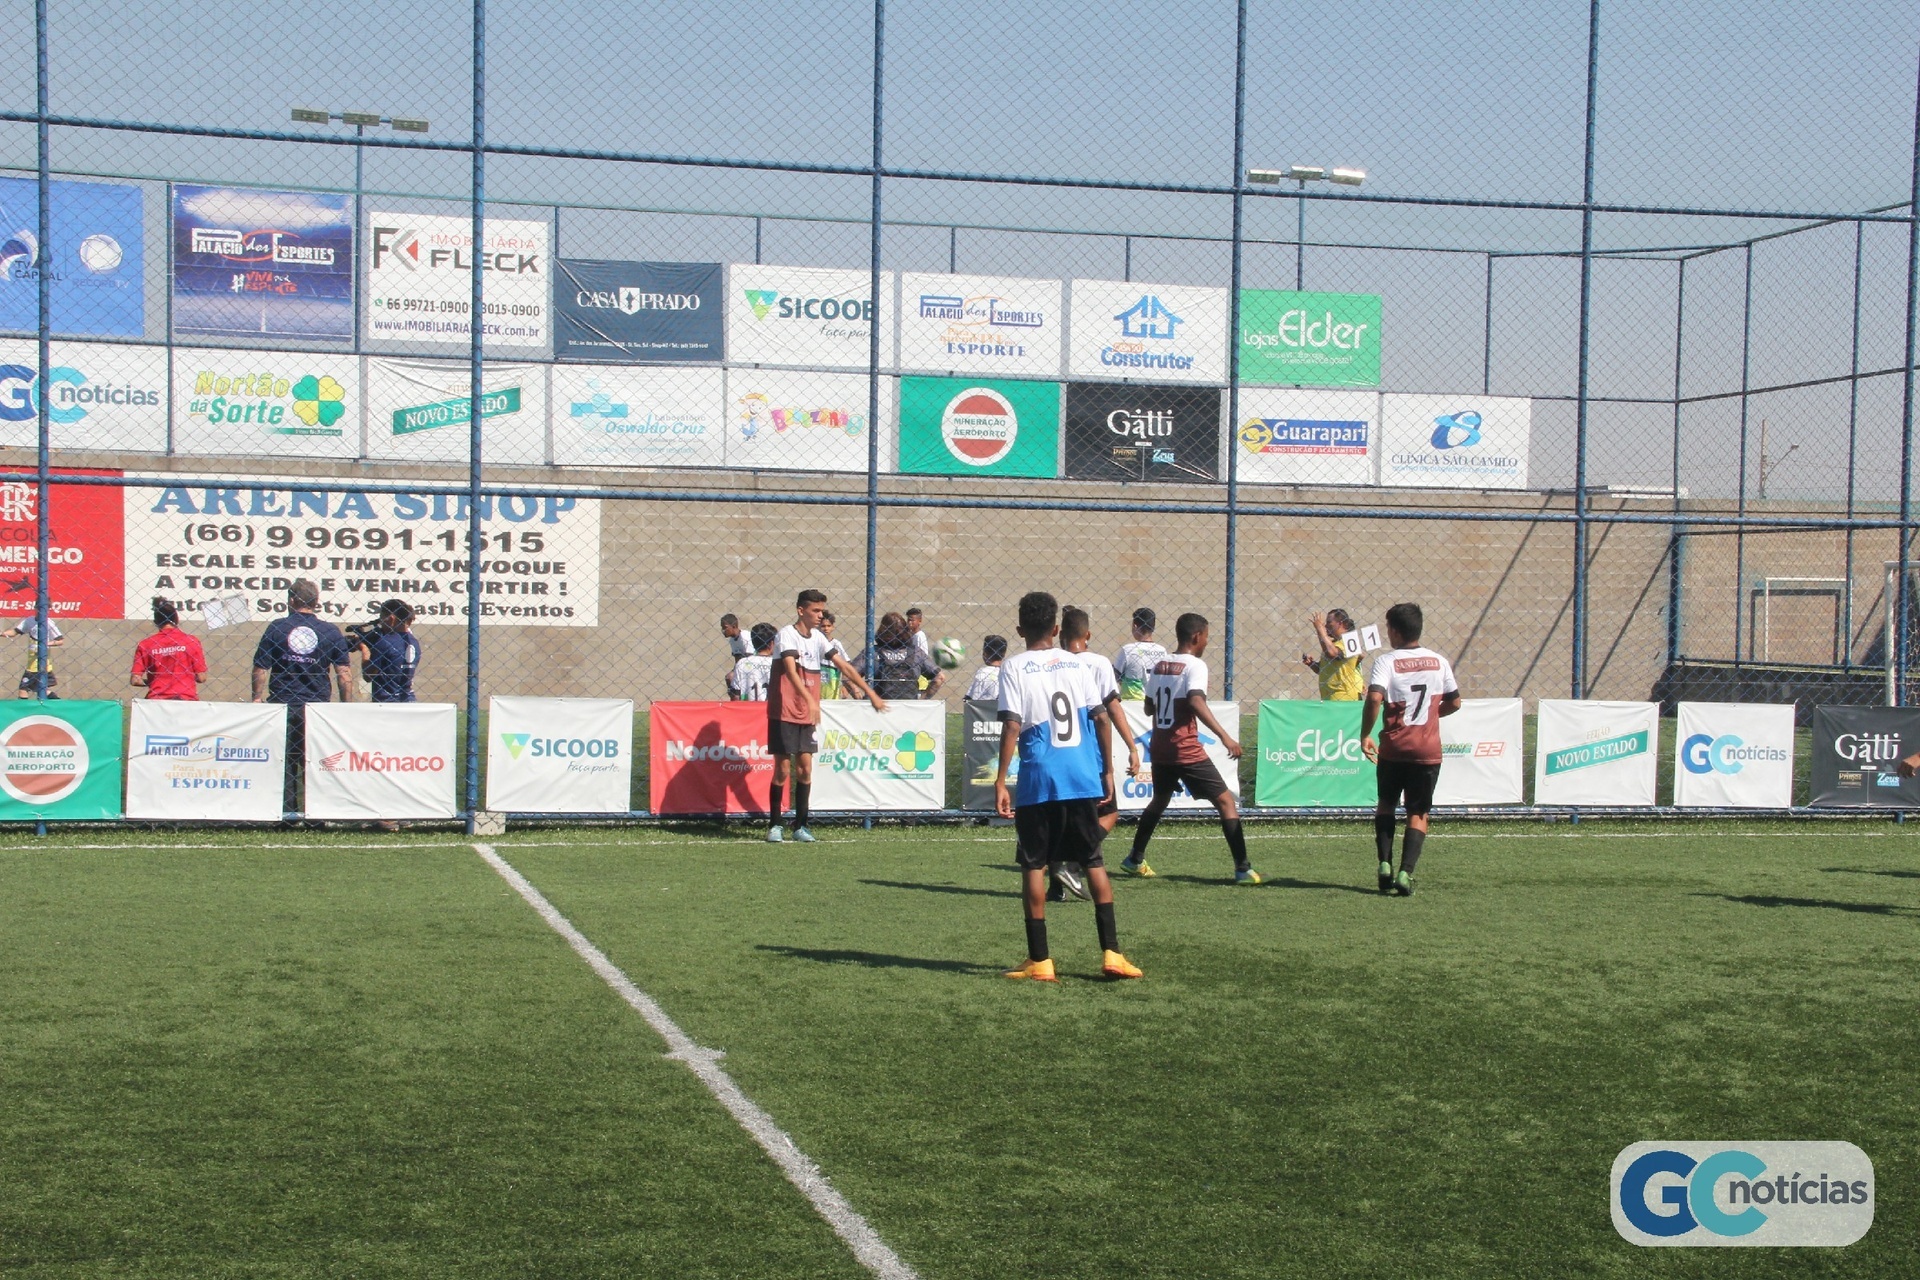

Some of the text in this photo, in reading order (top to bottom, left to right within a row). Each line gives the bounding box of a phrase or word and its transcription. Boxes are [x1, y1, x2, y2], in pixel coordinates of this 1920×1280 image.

[191, 227, 335, 265] PALACIO dos ESPORTES
[430, 249, 540, 274] FLECK
[14, 270, 63, 281] CAPAL
[576, 291, 701, 311] CASA PRADO
[989, 299, 1044, 328] ESPORTES
[374, 321, 540, 338] www.IMOBILIARIAECK.com.br
[1279, 309, 1368, 349] Elder
[1100, 346, 1195, 370] Construtor
[194, 370, 290, 398] Nortão
[404, 395, 508, 429] NOVO ESDO
[604, 412, 706, 435] Oswaldo Cruz
[953, 428, 1006, 438] AEROPORTO
[1272, 421, 1367, 446] Guarapari
[1471, 456, 1518, 467] CAMILO
[151, 487, 576, 524] ARENA SINOP
[184, 523, 545, 553] (66) 9 9691-1515
[156, 553, 566, 576] ESCALE SEU TIME, CONVOQUE
[155, 575, 175, 589] A
[321, 578, 336, 591] E
[345, 578, 440, 594] VENHA
[256, 598, 349, 617] Soety
[366, 600, 455, 616] Sash
[479, 602, 574, 618] Eventos
[1367, 632, 1377, 646] 1
[1156, 686, 1171, 725] 12
[1410, 684, 1427, 722] 7
[1051, 691, 1073, 742] 9
[145, 735, 269, 762] PALACIO dos ESPORTES
[531, 738, 619, 759] SICOOB
[823, 729, 894, 750] Nortão
[7, 748, 75, 760] MINERAÇÃO
[349, 751, 445, 773] Mônaco
[1265, 747, 1297, 766] Lojas
[1555, 736, 1638, 769] NOVO ESTADO
[1726, 745, 1787, 761] notícias
[7, 763, 76, 771] AEROPORTO
[172, 777, 252, 790] ESPORTE
